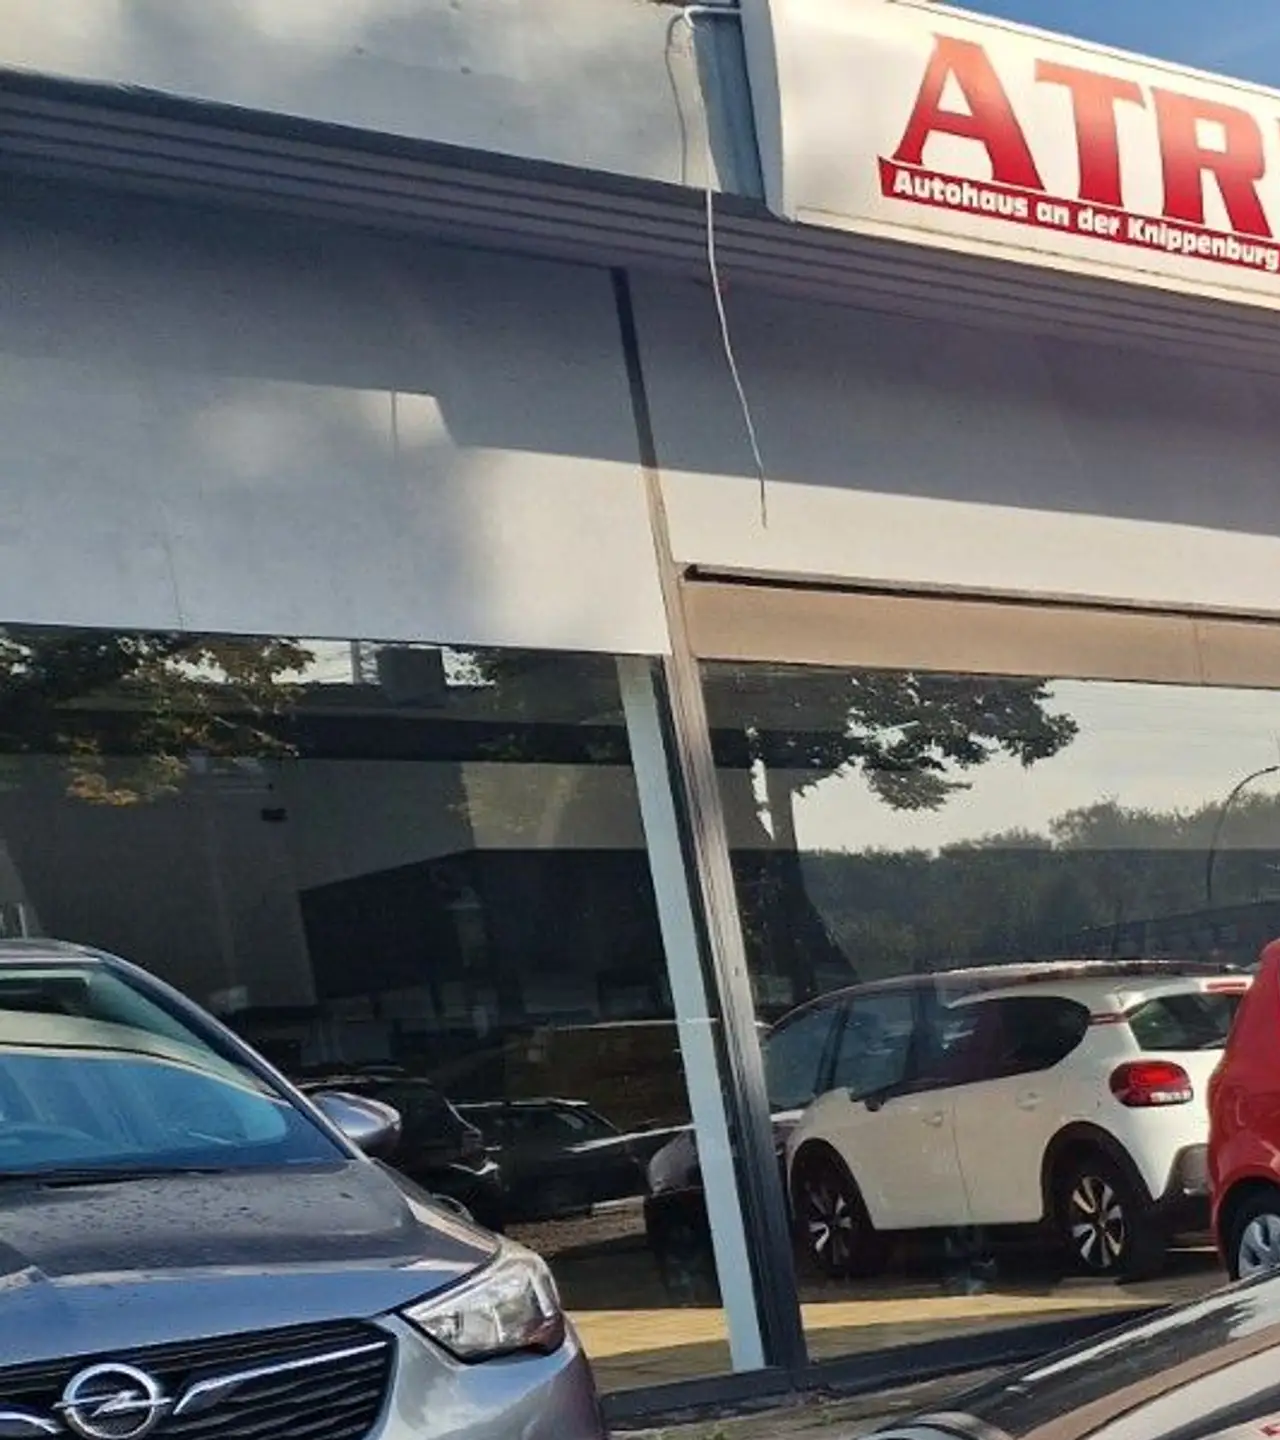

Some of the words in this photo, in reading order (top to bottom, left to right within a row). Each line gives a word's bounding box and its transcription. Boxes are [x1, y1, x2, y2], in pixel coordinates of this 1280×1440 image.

[892, 169, 1029, 219] Autohaus
[1036, 201, 1070, 227] an
[1077, 205, 1122, 239] der
[1127, 216, 1280, 272] Knippenburg
